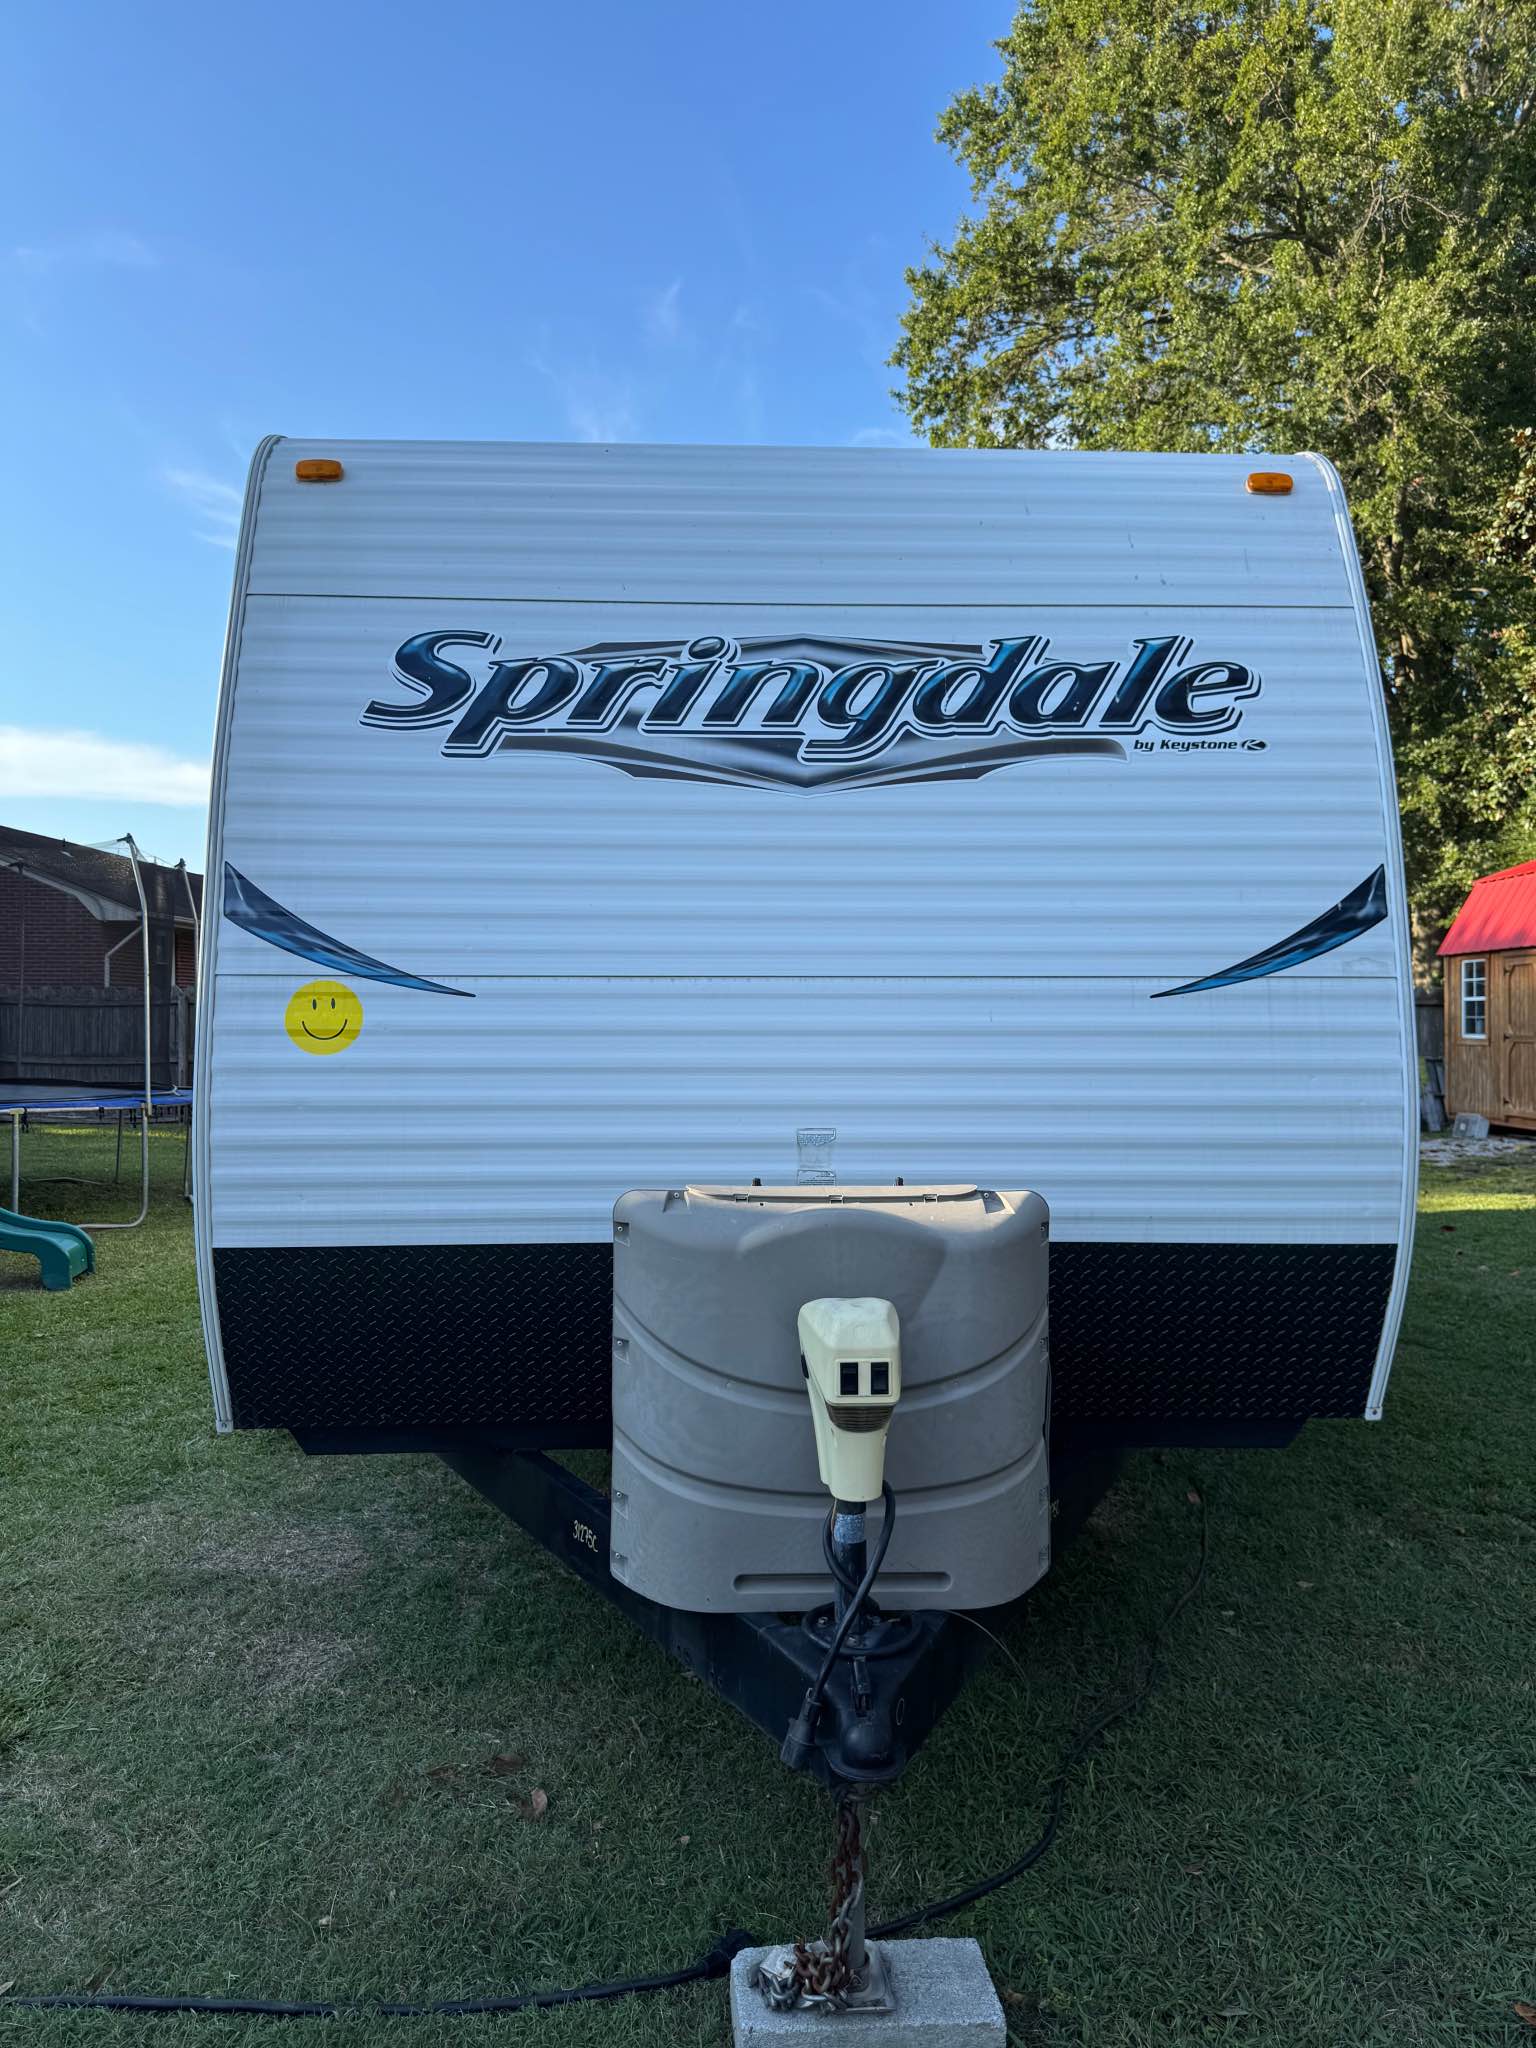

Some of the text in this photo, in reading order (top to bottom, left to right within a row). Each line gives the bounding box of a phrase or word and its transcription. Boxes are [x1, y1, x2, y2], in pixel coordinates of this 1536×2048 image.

[359, 630, 1261, 761] Springdale
[1133, 739, 1238, 752] by Keystone
